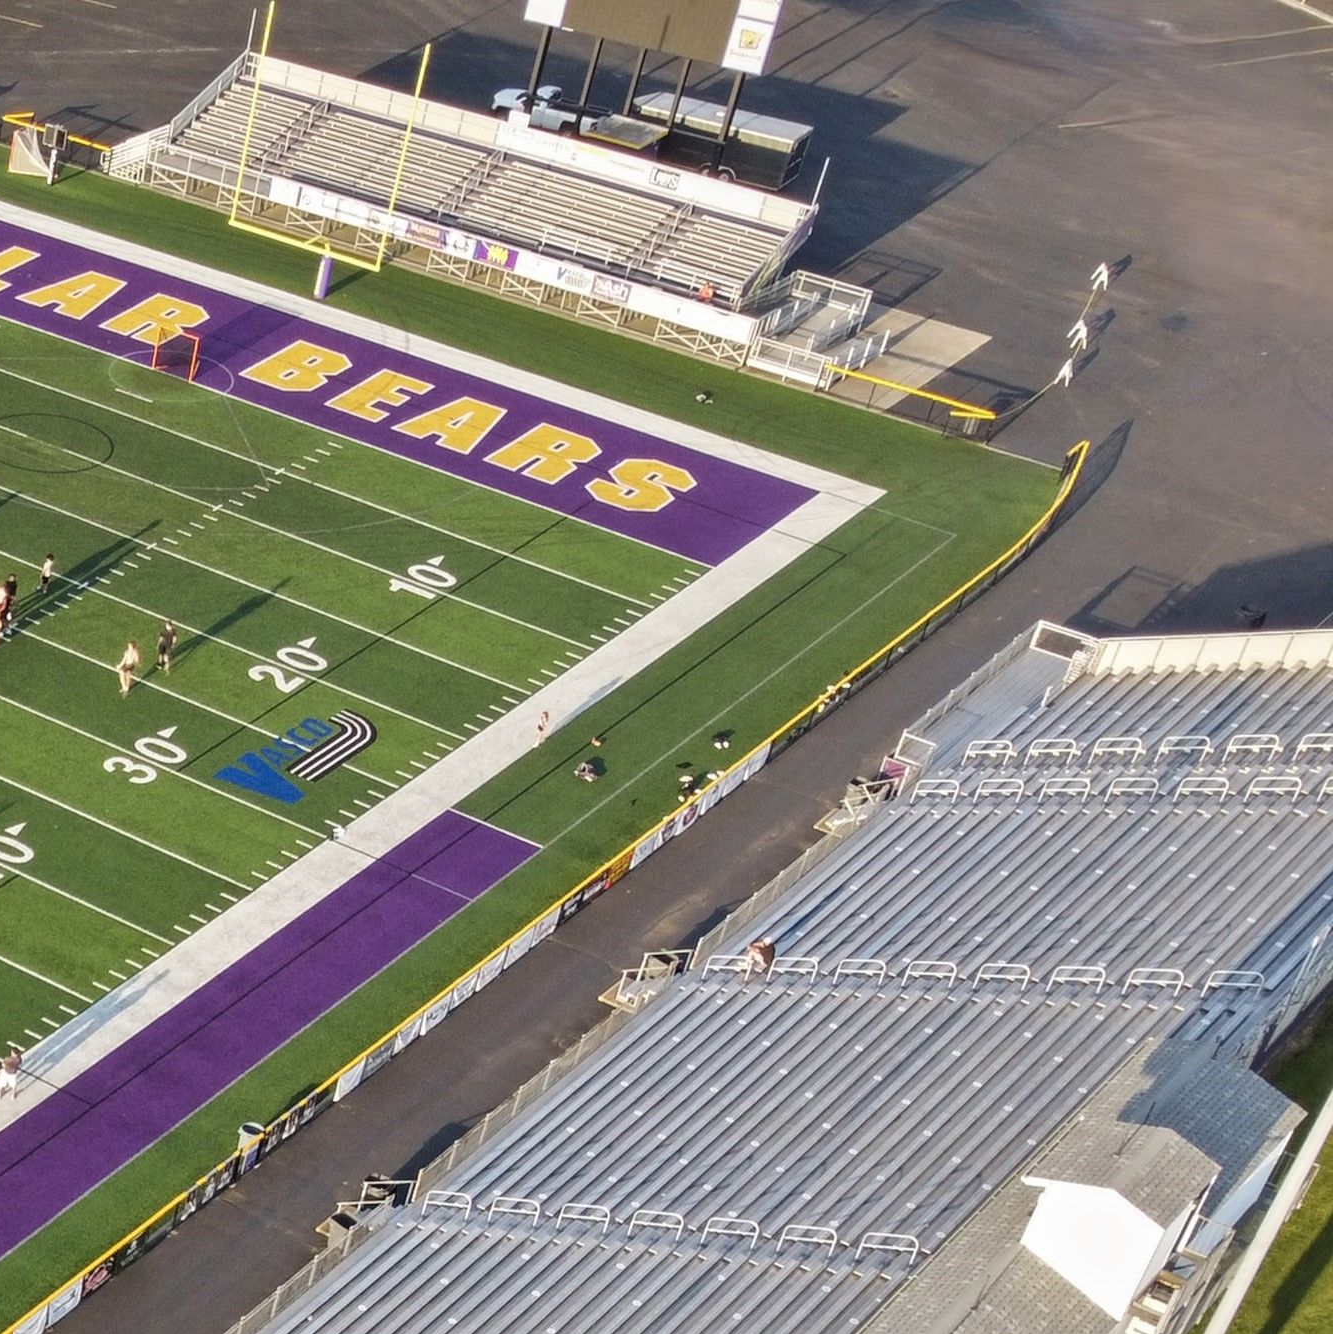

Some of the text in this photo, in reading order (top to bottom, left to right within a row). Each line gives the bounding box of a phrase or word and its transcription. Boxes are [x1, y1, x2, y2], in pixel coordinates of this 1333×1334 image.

[241, 340, 699, 513] BEARS
[388, 564, 457, 600] 10
[248, 647, 328, 693] 20
[103, 736, 187, 784] 30
